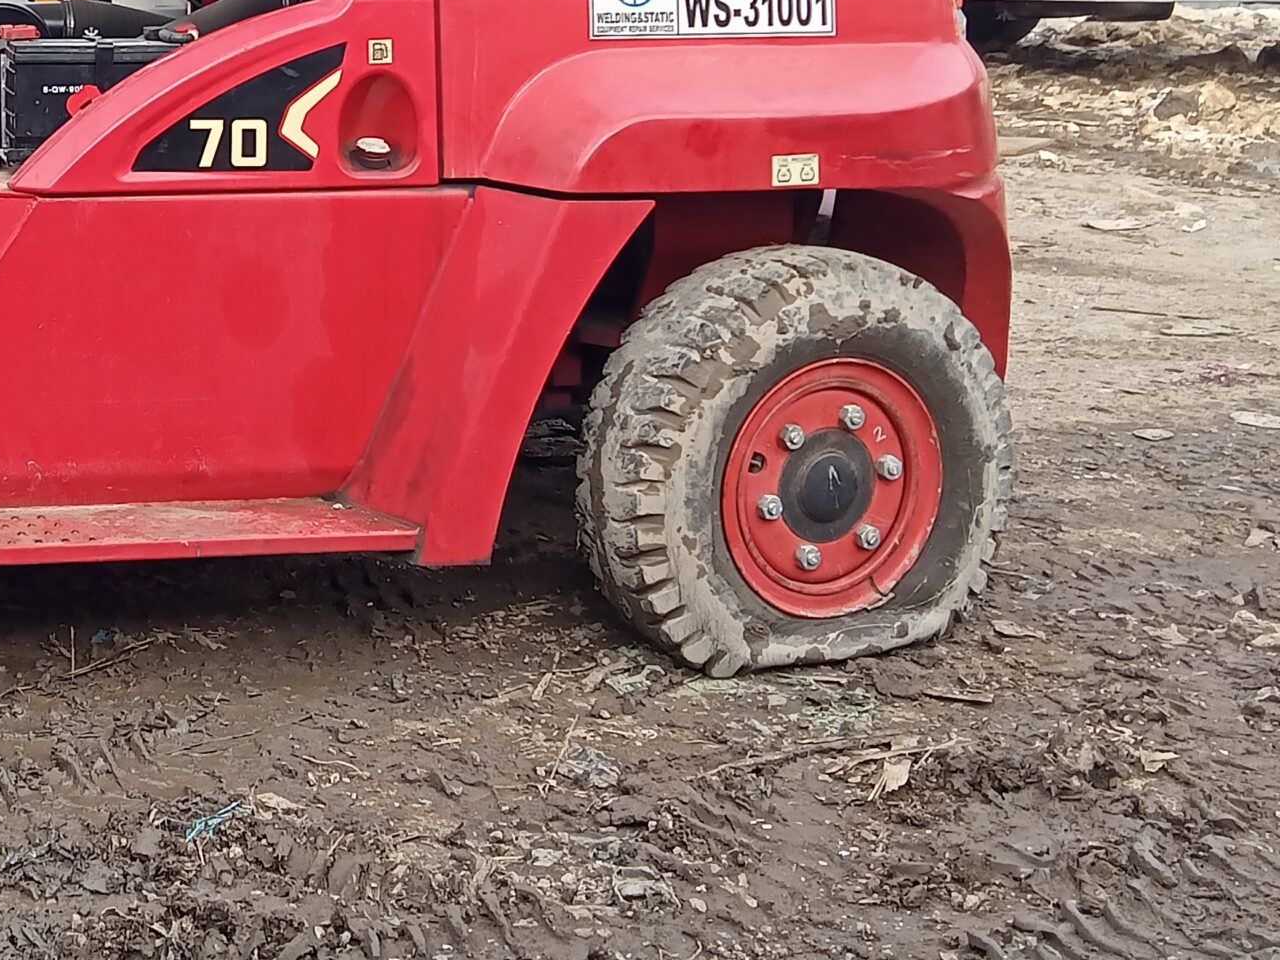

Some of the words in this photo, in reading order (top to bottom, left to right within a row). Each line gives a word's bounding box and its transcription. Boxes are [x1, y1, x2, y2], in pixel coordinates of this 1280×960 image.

[596, 11, 675, 24] WELDING&STATIC
[189, 119, 267, 168] 70
[872, 425, 887, 443] 2
